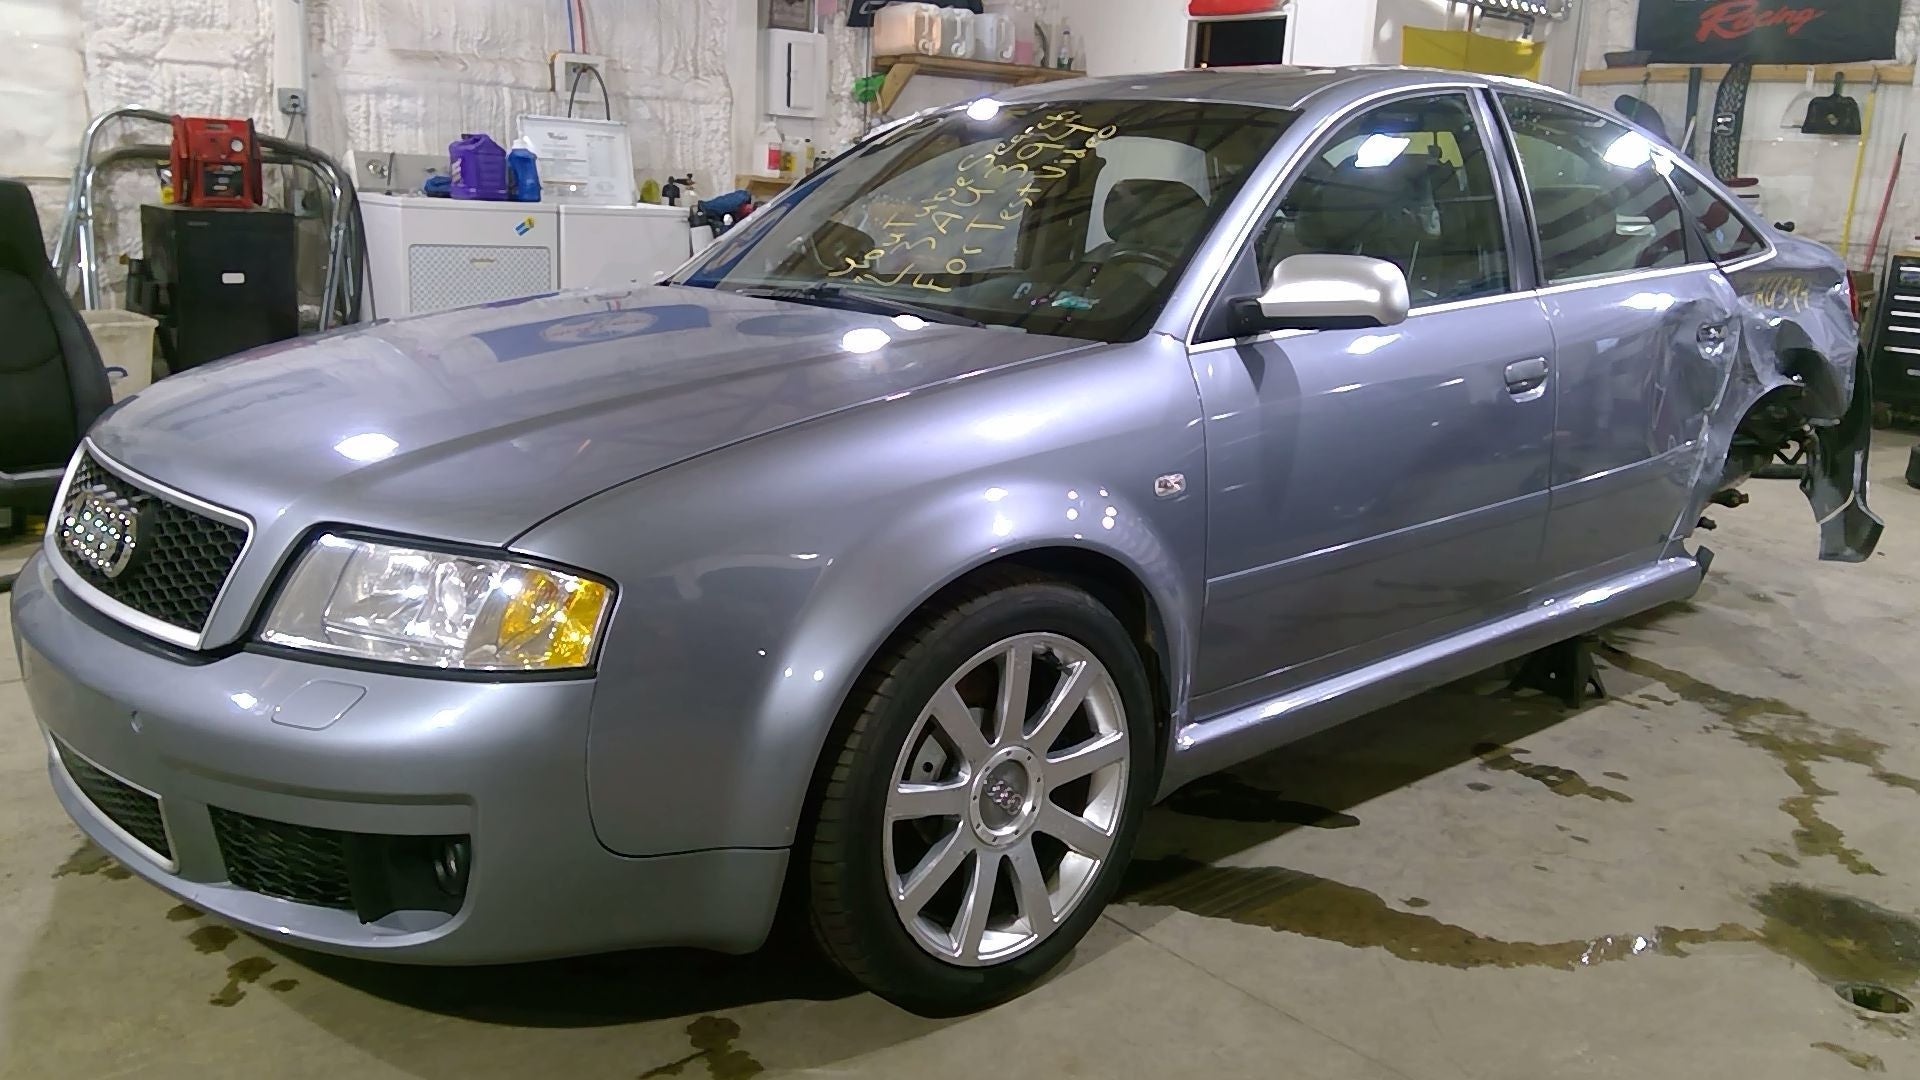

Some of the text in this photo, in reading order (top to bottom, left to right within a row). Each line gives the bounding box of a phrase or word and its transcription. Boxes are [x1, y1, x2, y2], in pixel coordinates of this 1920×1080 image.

[1695, 0, 1826, 43] Racing
[912, 125, 1118, 293] For Test Video
